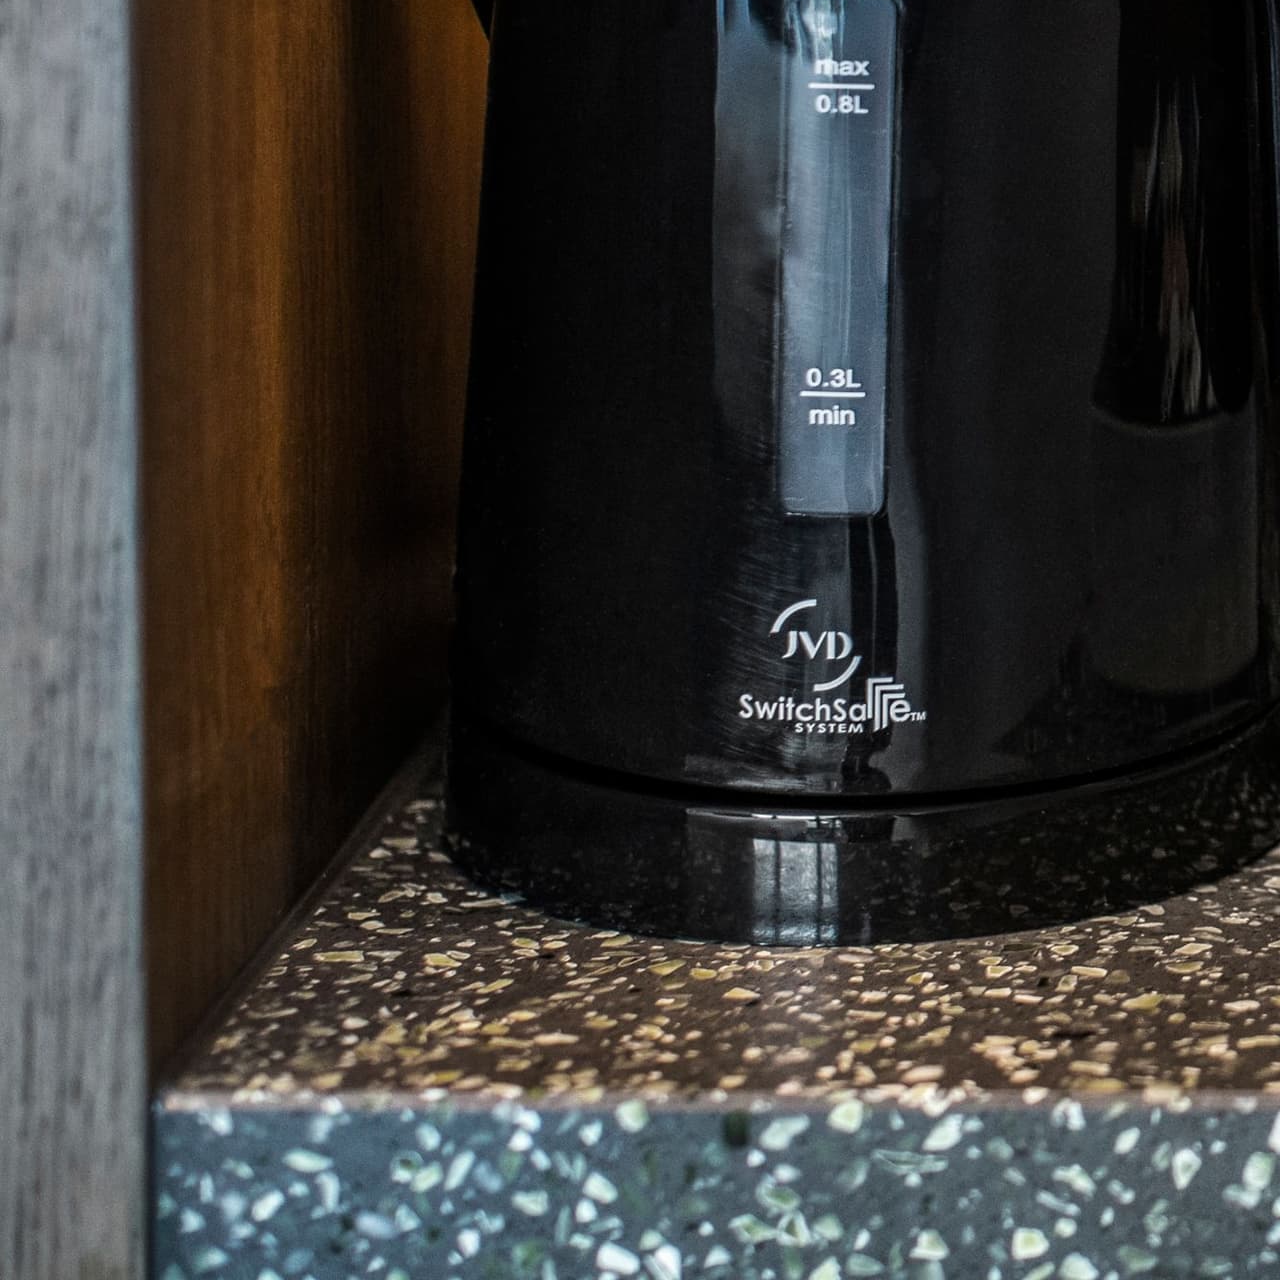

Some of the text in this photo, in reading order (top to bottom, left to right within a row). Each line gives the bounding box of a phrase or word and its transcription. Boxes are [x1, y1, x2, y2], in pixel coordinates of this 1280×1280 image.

[815, 59, 870, 77] max
[815, 94, 869, 114] 0.8L
[806, 368, 862, 389] 0.3L
[808, 405, 856, 426] min
[781, 630, 853, 660] JVD
[795, 722, 864, 734] SYSTEM
